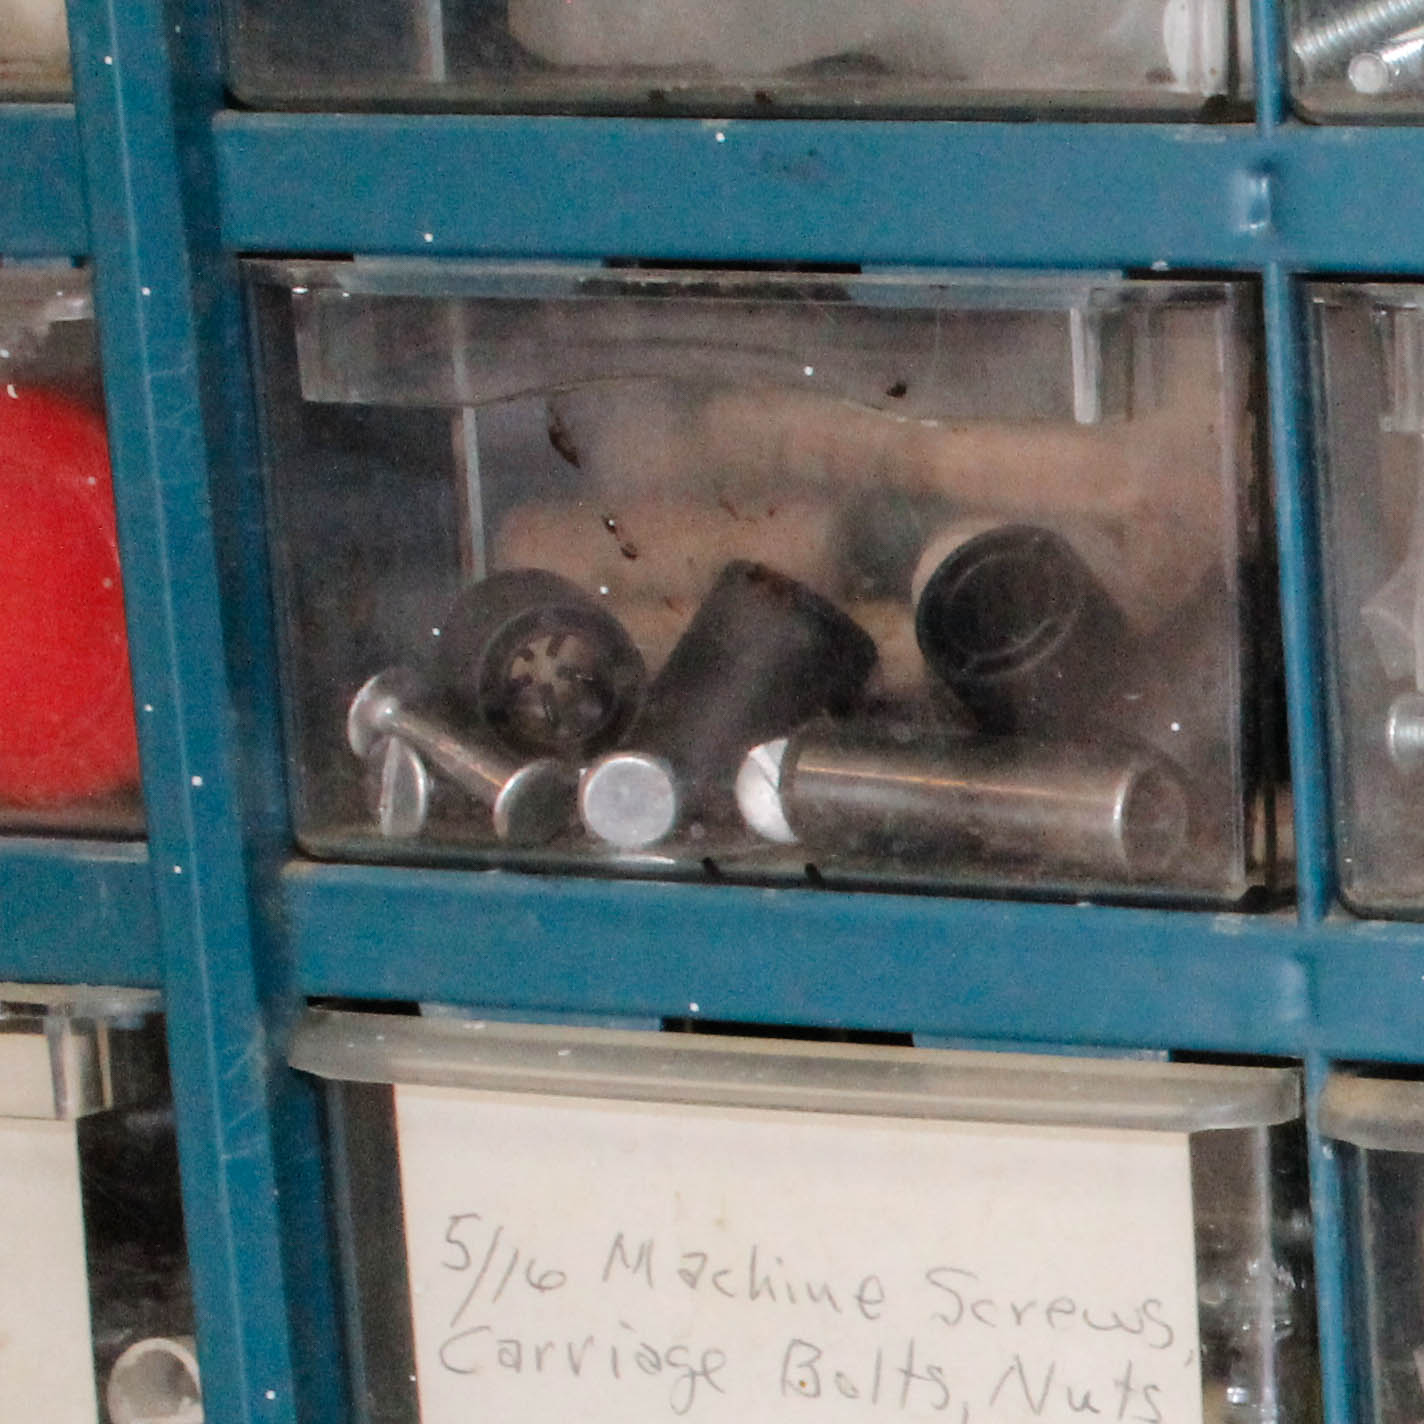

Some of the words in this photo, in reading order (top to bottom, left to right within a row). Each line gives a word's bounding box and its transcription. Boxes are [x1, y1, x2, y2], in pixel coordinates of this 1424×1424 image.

[439, 1212, 567, 1327] 5/16
[603, 1232, 887, 1322] Machine
[437, 1321, 727, 1416] Carriage
